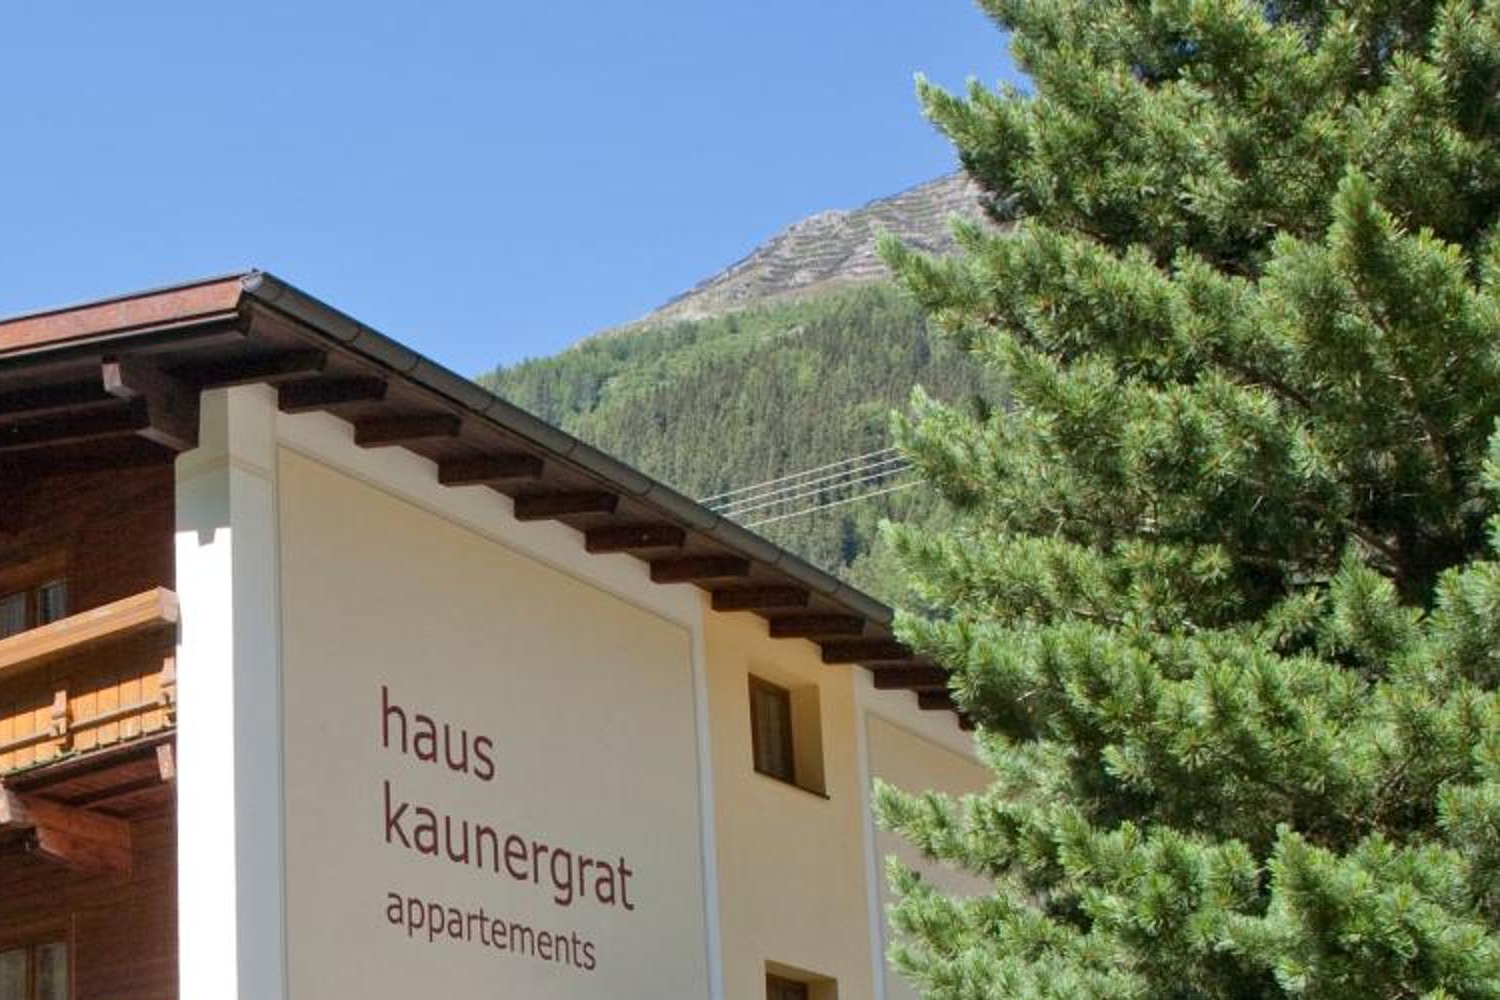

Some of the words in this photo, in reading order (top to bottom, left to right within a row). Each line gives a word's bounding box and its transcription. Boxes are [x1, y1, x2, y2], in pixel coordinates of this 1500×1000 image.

[381, 685, 495, 781] haus
[384, 780, 634, 910] kaunergrat
[387, 892, 596, 970] appartements
